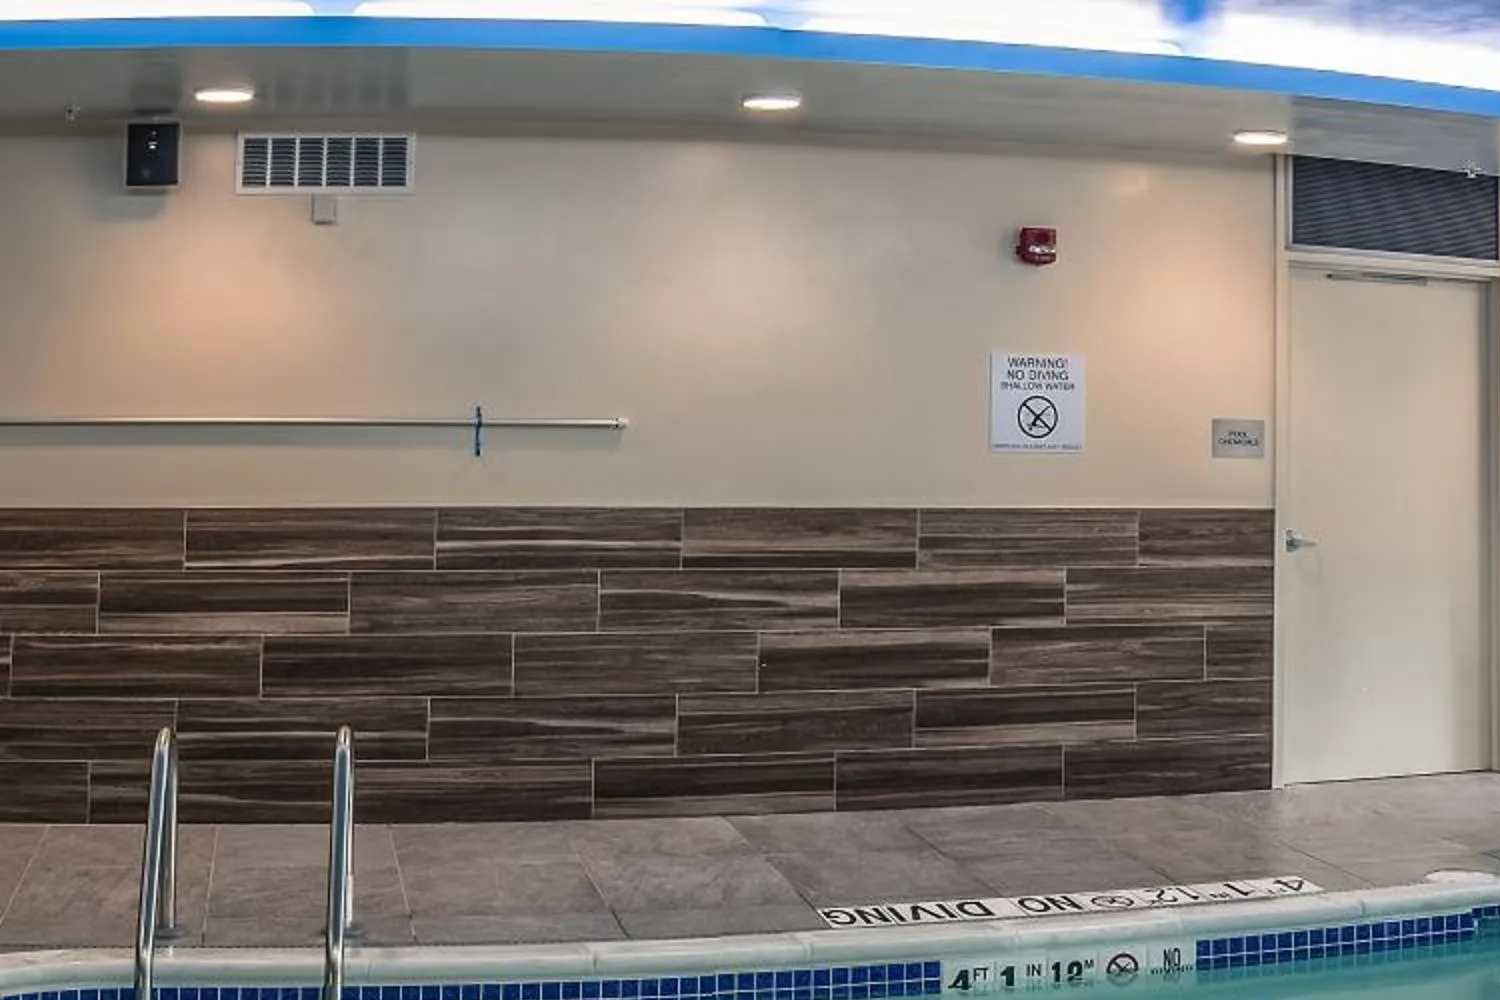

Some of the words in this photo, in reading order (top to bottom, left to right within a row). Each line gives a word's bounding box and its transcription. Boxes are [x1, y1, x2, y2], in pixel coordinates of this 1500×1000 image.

[1007, 369, 1025, 381] NO
[823, 901, 996, 925] DIVING
[948, 969, 972, 990] 4
[974, 967, 989, 981] FT
[1000, 965, 1016, 987] 1
[1026, 963, 1042, 977] IN
